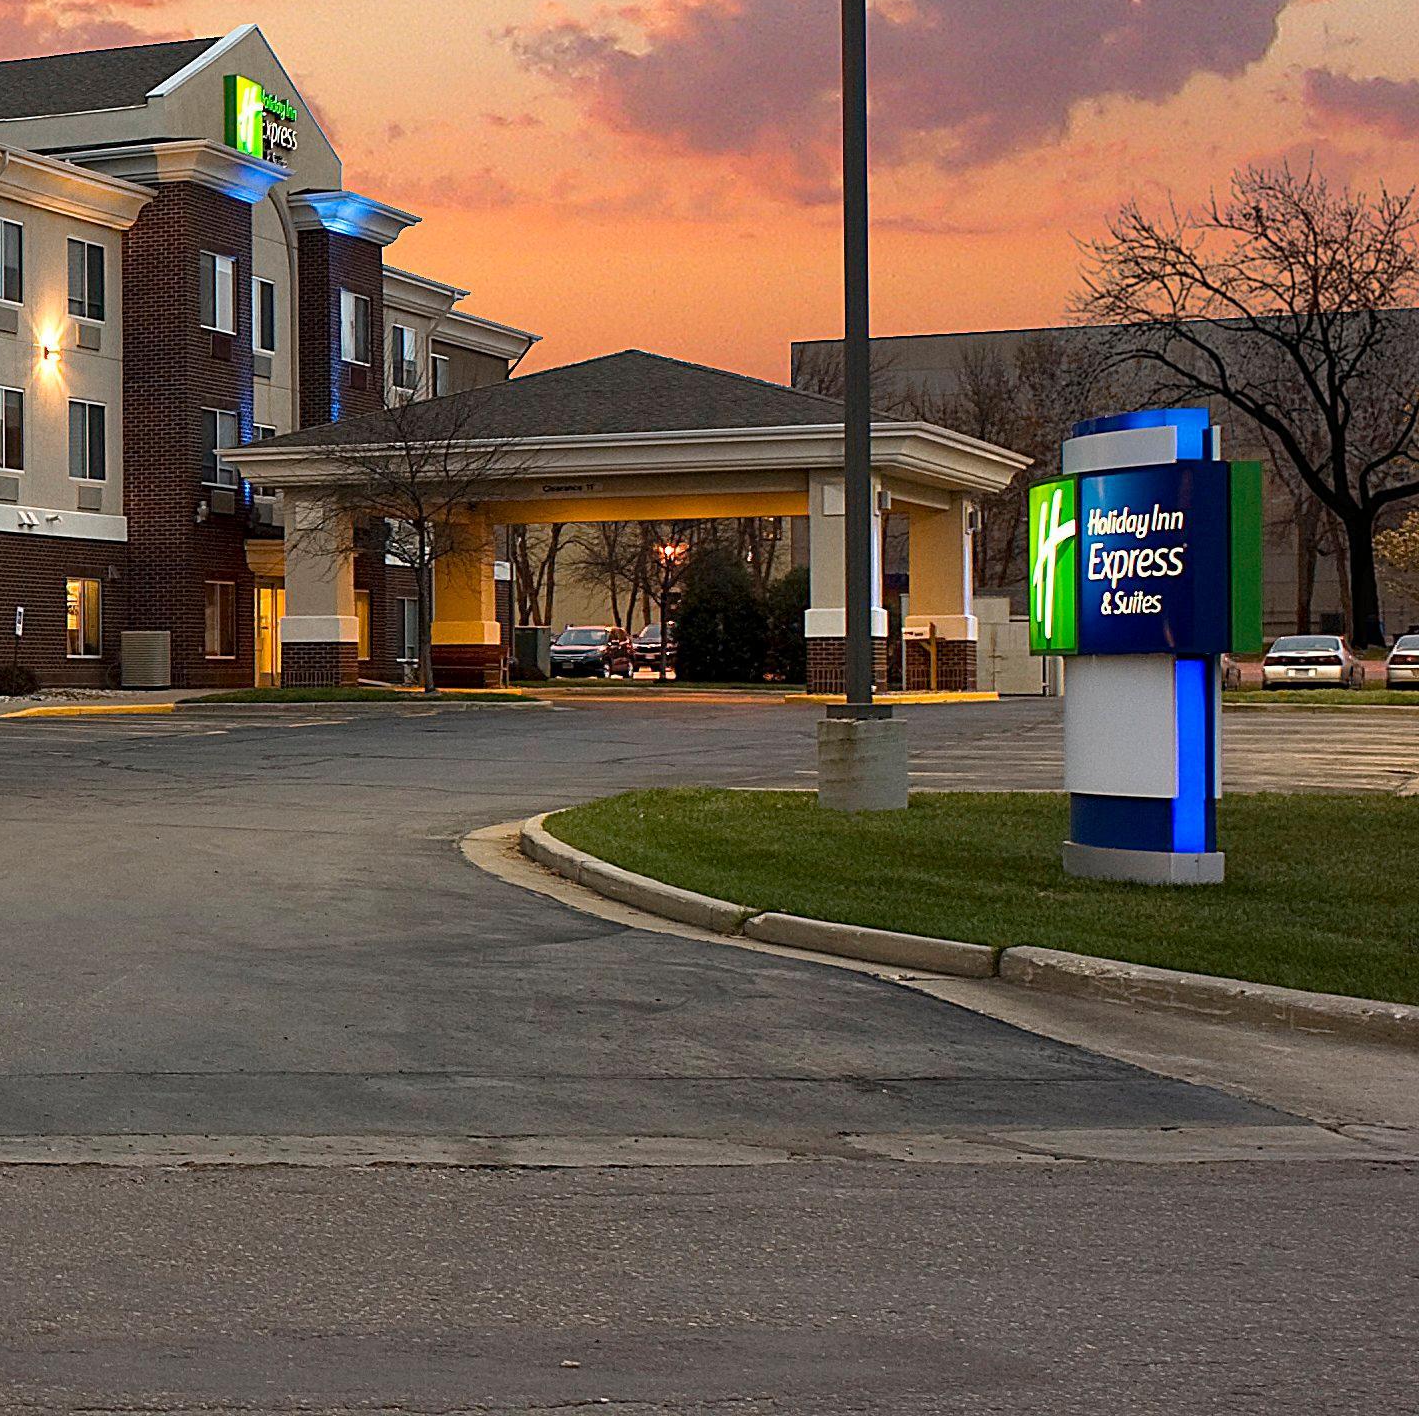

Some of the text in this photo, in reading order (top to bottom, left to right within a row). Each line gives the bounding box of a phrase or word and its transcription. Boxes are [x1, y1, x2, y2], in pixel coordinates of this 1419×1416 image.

[1087, 503, 1184, 538] Holiday Inn
[1087, 543, 1184, 589] Express
[1100, 590, 1162, 615] & Suites
